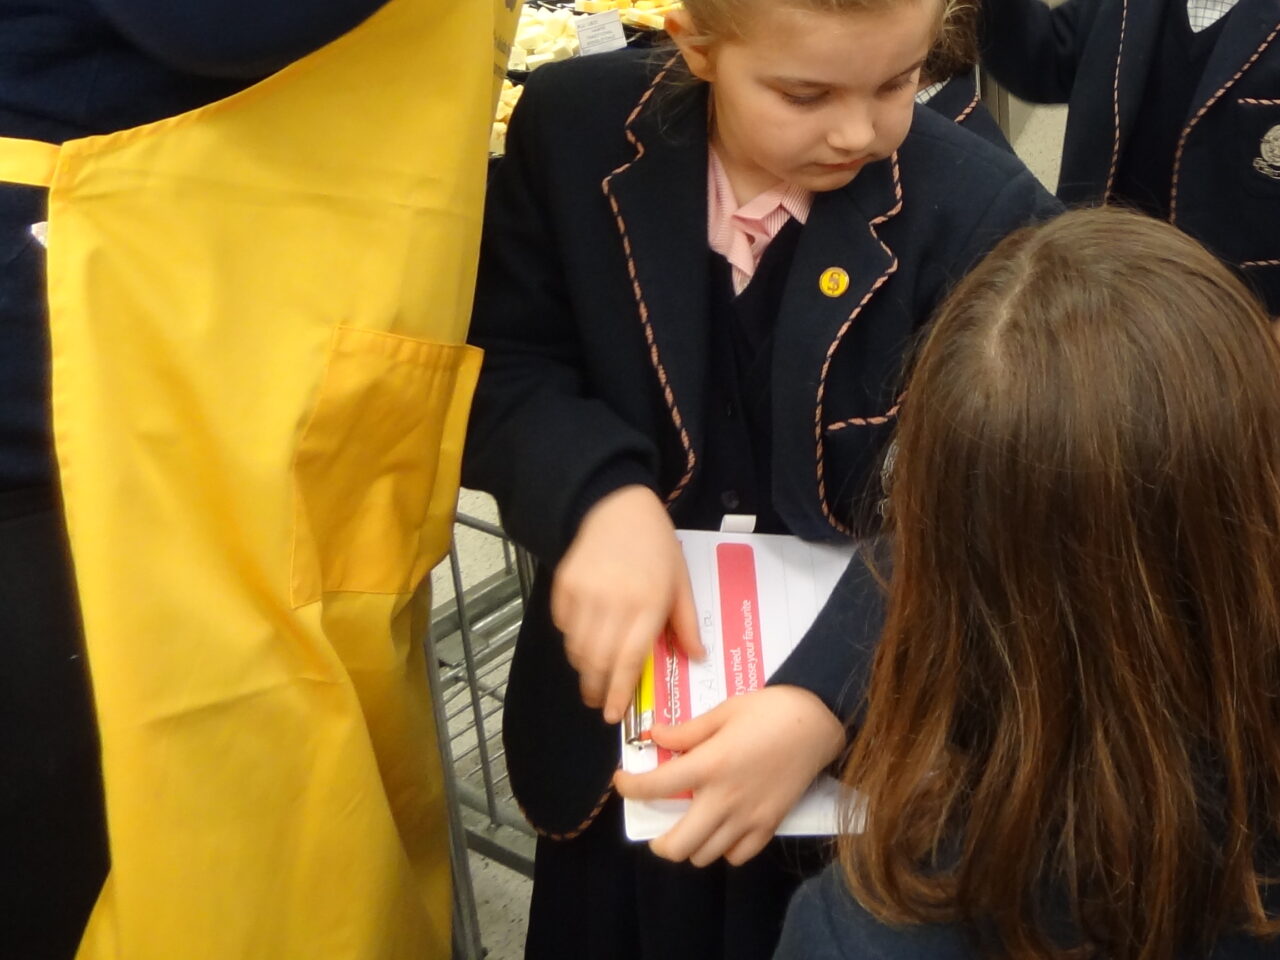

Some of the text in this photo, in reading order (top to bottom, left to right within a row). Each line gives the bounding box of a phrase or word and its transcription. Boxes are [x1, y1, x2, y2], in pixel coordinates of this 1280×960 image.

[742, 599, 759, 694] hoose your favourite
[729, 647, 743, 671] tried.
[734, 672, 746, 693] you
